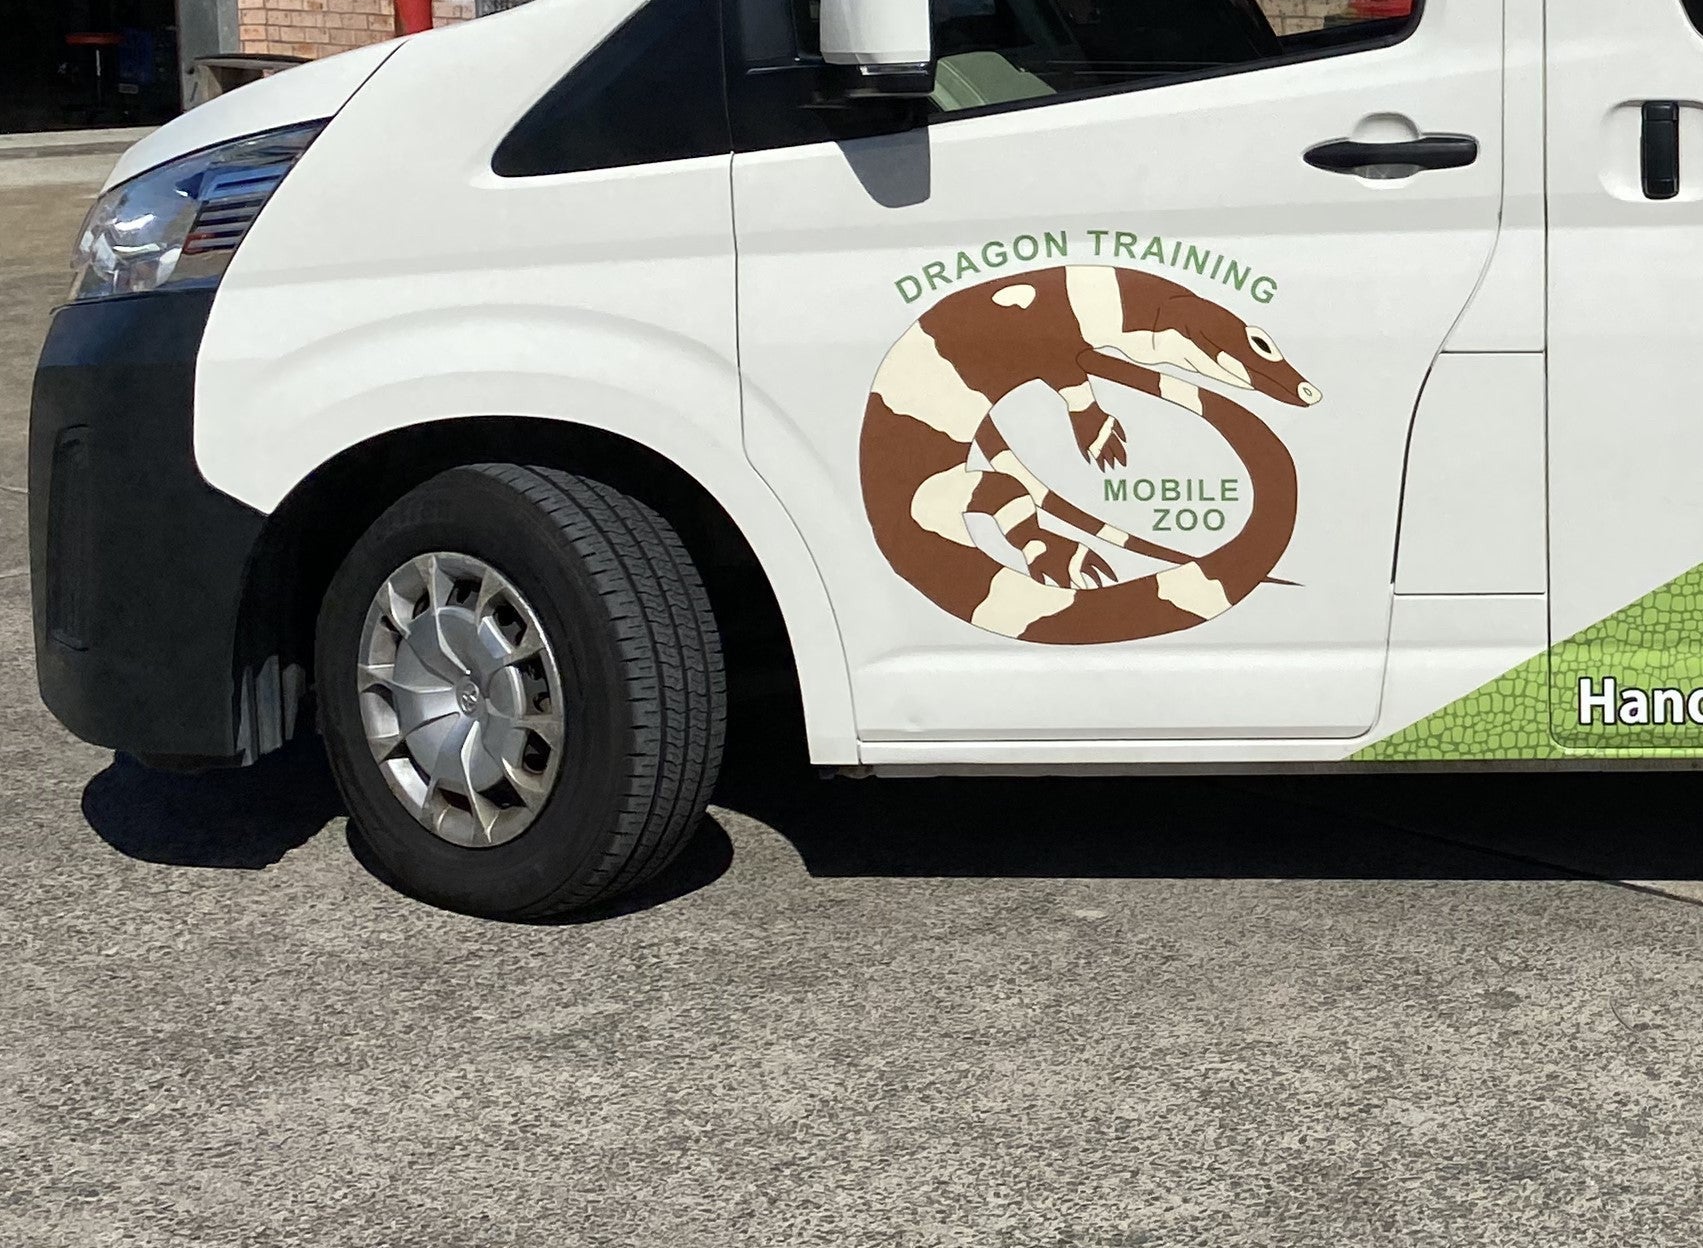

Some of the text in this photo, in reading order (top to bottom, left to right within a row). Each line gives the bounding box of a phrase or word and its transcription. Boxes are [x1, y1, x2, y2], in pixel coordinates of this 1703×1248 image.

[894, 230, 1279, 304] DRAGON TRAINING
[1103, 478, 1239, 502] MOBILE
[1151, 508, 1226, 532] ZOO
